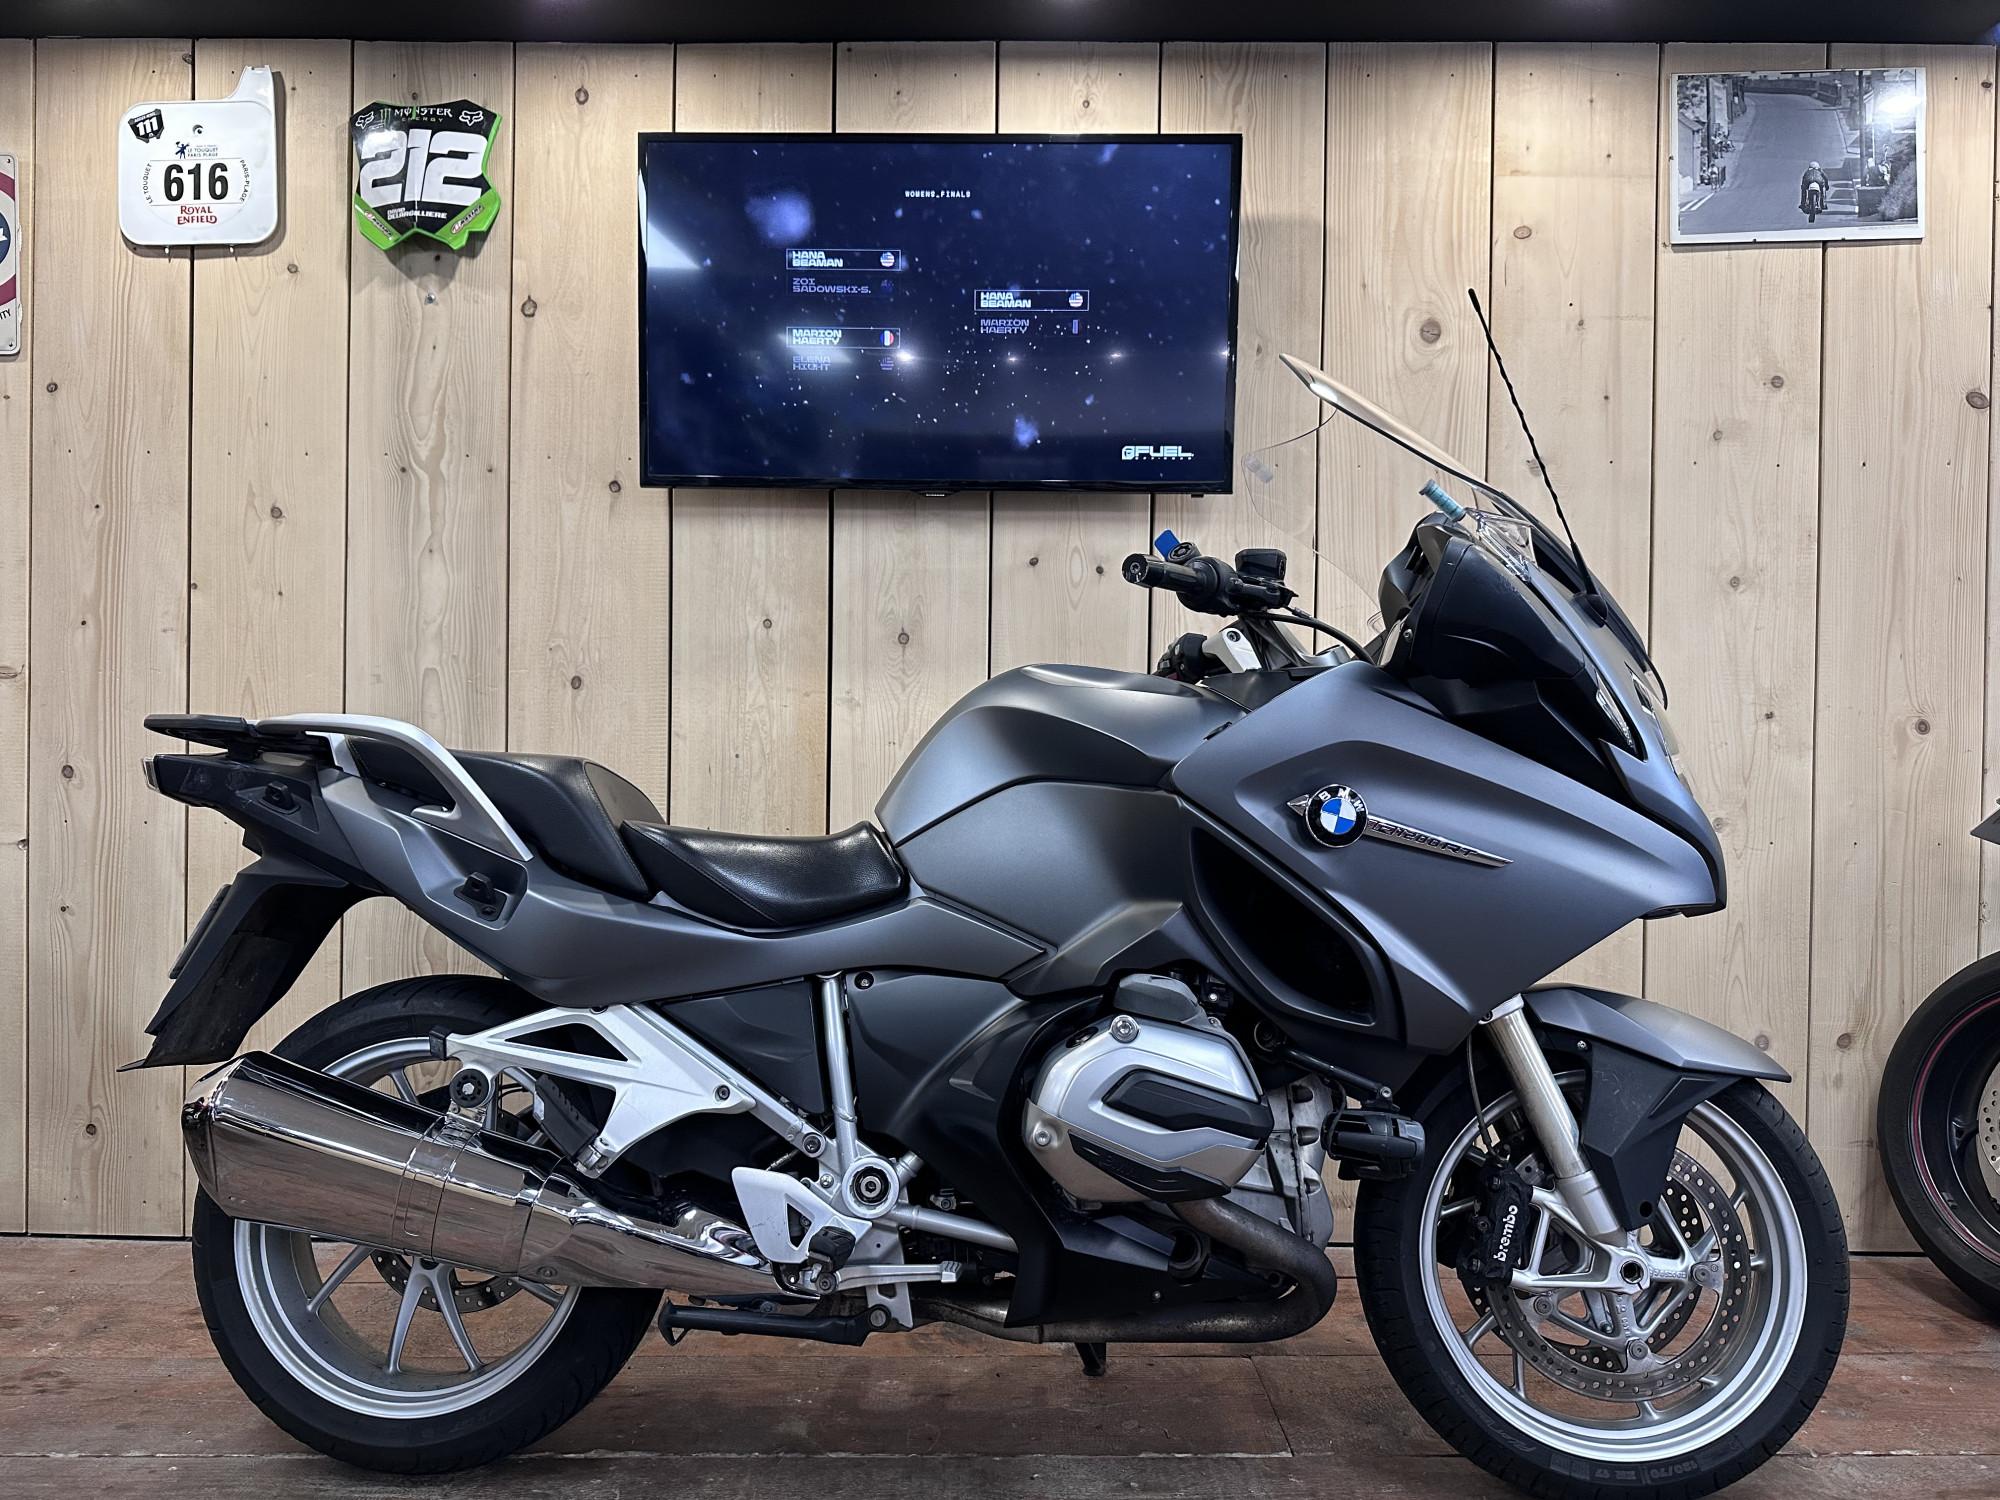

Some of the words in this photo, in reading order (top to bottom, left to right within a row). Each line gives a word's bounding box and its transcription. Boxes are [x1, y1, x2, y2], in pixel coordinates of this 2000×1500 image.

[394, 106, 453, 117] MONSTER
[136, 116, 159, 136] 111
[360, 129, 488, 208] 212
[142, 163, 152, 194] TOUQUET
[164, 163, 228, 202] 616
[180, 206, 213, 214] ROYAL
[177, 214, 217, 225] ENFIELD
[792, 251, 825, 259] HANA
[792, 259, 843, 267] BEAMAN
[980, 292, 1013, 300] HANA
[980, 299, 1031, 308] BEAMAN
[980, 319, 1029, 327] MARION
[793, 329, 841, 337] MARION
[980, 326, 1027, 334] HAERTY
[793, 337, 840, 345] HAERTY
[793, 355, 830, 363] ELENA
[1319, 787, 1365, 813] BMW
[1493, 1205, 1518, 1261] brembo
